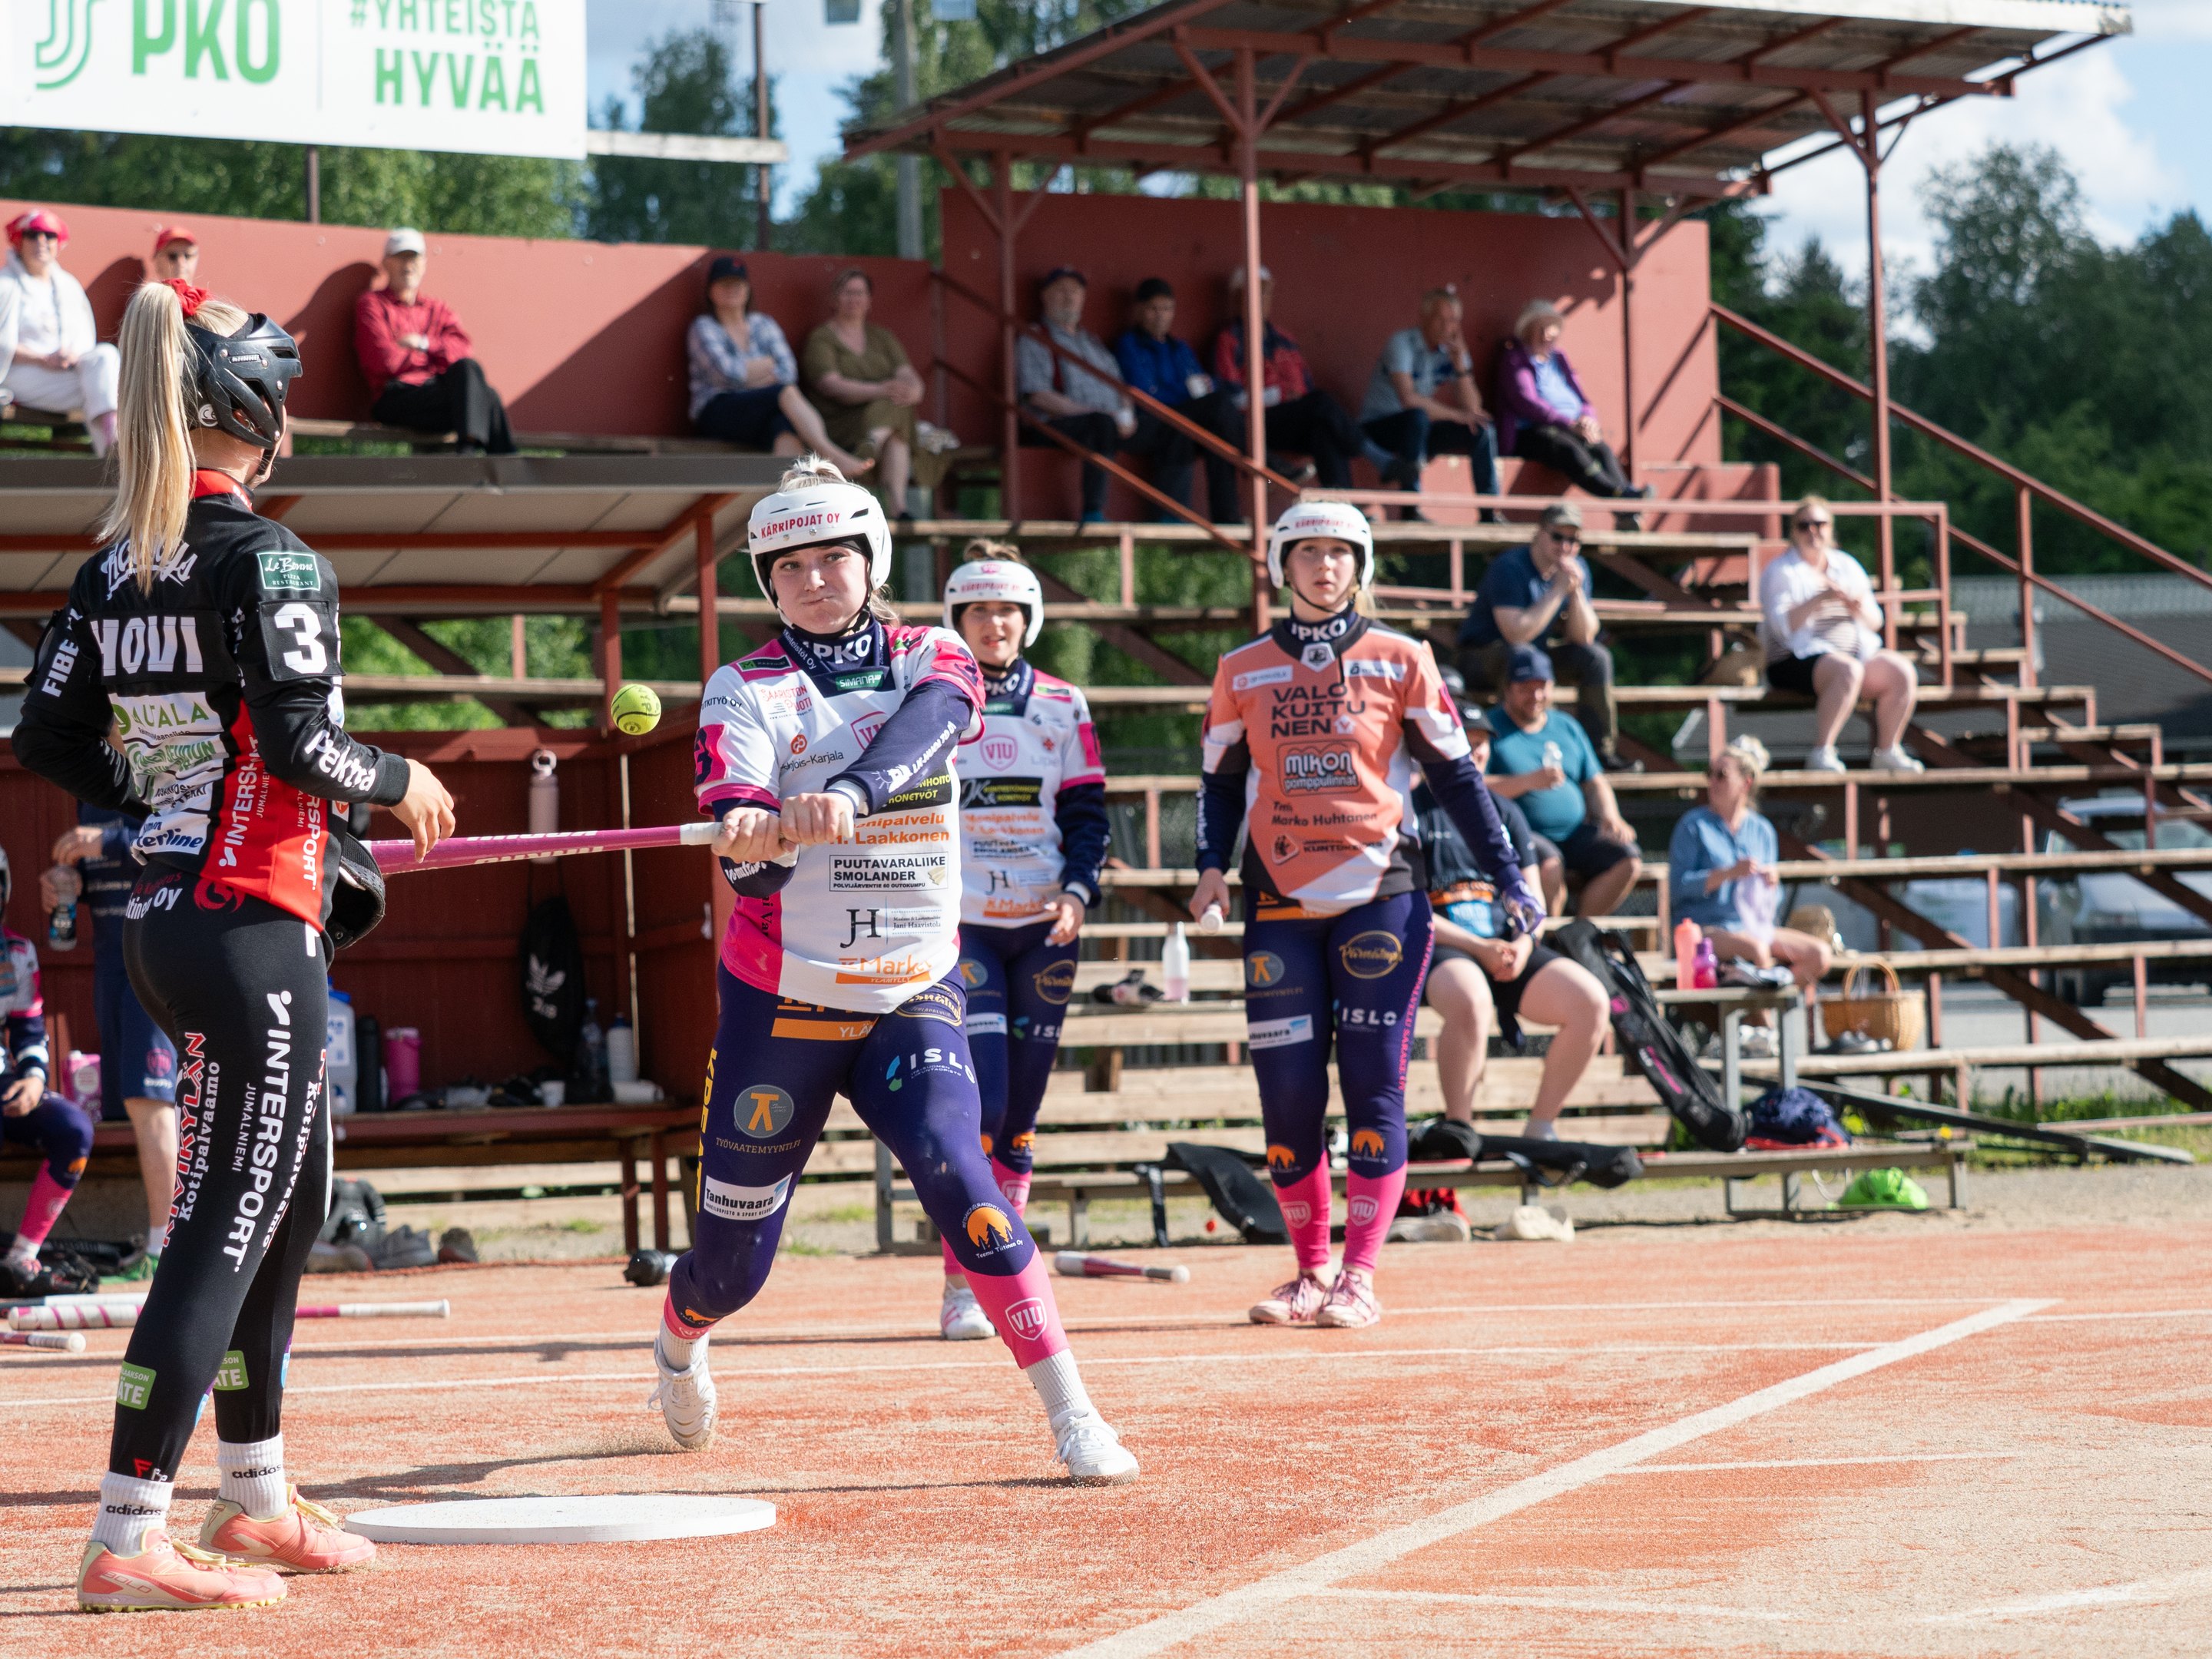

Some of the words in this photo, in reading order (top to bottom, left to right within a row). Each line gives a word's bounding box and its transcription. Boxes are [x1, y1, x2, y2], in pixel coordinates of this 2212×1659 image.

[132, 0, 280, 84] PKO
[375, 41, 544, 113] HYVÄÄ
[826, 512, 840, 524] OY
[273, 603, 329, 674] 3
[1297, 618, 1348, 642] PKO
[813, 634, 873, 664] PKO
[1272, 682, 1349, 704] VALO
[1271, 700, 1366, 720] KUITU
[1270, 718, 1332, 739] NEN
[855, 830, 950, 846] Laakkonen
[834, 856, 946, 869] PUUTAVARALIIKE
[833, 871, 916, 881] SMOLANDER
[154, 887, 184, 911] Oy
[839, 909, 882, 949] JH
[909, 1048, 975, 1084] ISLO
[231, 1082, 257, 1173] JUMALNIEMI
[178, 1061, 220, 1222] Kotipalvaamo
[223, 1029, 291, 1269] INTERSPORT
[716, 1137, 801, 1154] TYÖVAATEMYYNTI.FI
[706, 1187, 774, 1210] Tanhuvaara
[1011, 1306, 1042, 1330] VIU
[232, 1463, 282, 1479] adidas
[105, 1504, 161, 1516] adidas
